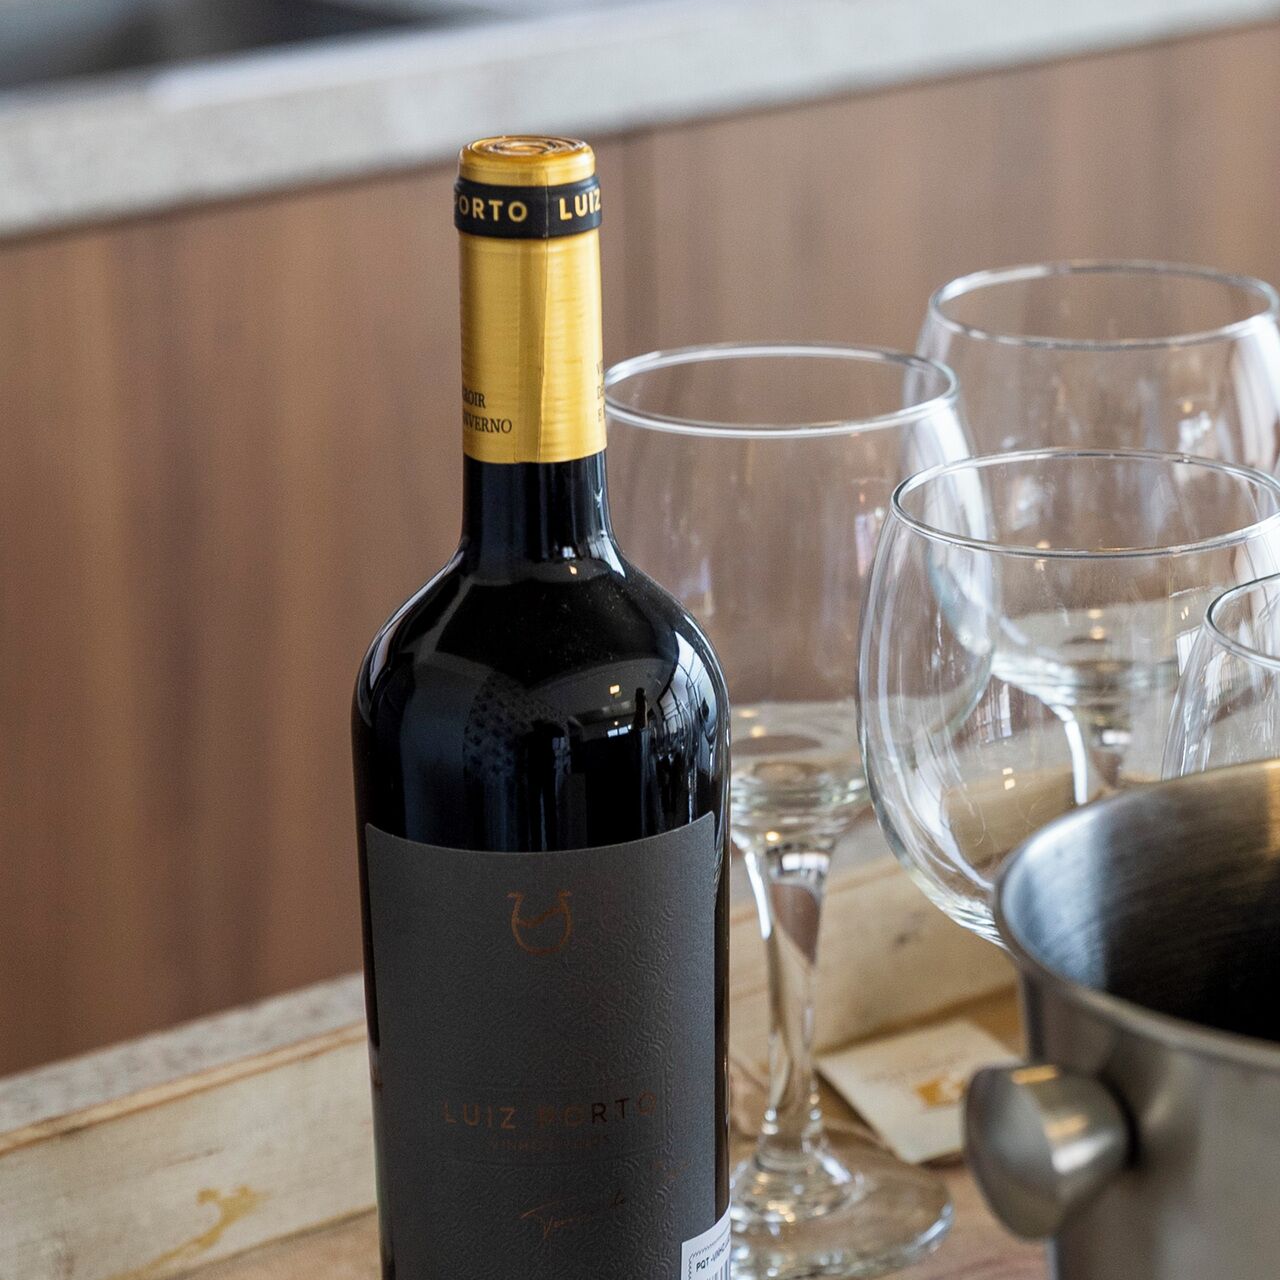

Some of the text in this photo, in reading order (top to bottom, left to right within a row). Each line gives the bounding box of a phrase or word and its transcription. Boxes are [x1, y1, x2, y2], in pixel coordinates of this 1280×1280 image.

[455, 188, 601, 222] ORTO LUIZ
[442, 1089, 658, 1131] LUIZ PORTO
